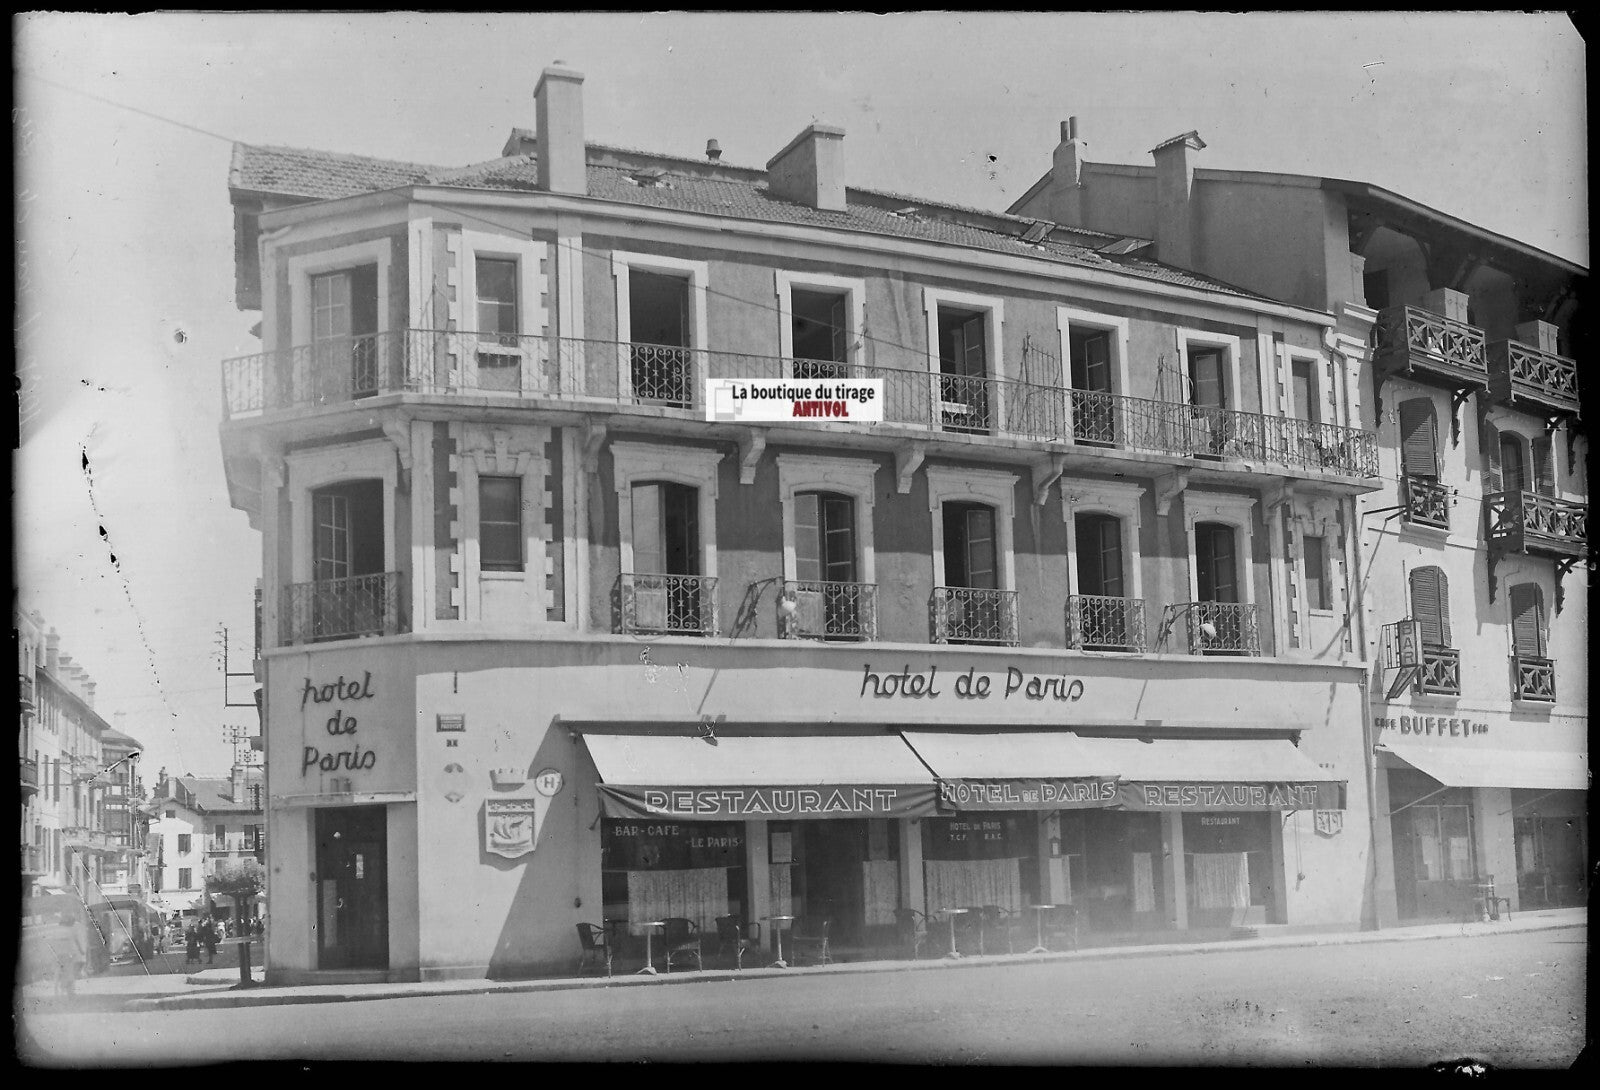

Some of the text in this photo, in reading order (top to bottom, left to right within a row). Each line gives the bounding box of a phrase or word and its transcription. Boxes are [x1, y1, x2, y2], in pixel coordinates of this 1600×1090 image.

[1403, 625, 1414, 663] BAR
[301, 670, 375, 712] hotel
[860, 664, 1084, 701] hotel de Paris
[326, 709, 358, 736] de
[1399, 715, 1471, 738] BUFFET
[302, 743, 377, 777] Paris
[544, 776, 555, 788] H
[941, 781, 1117, 803] HOTEL DE PARIS
[644, 789, 897, 814] RESTAURANT
[1143, 785, 1317, 806] RESTAURANT
[707, 837, 740, 848] PARIS
